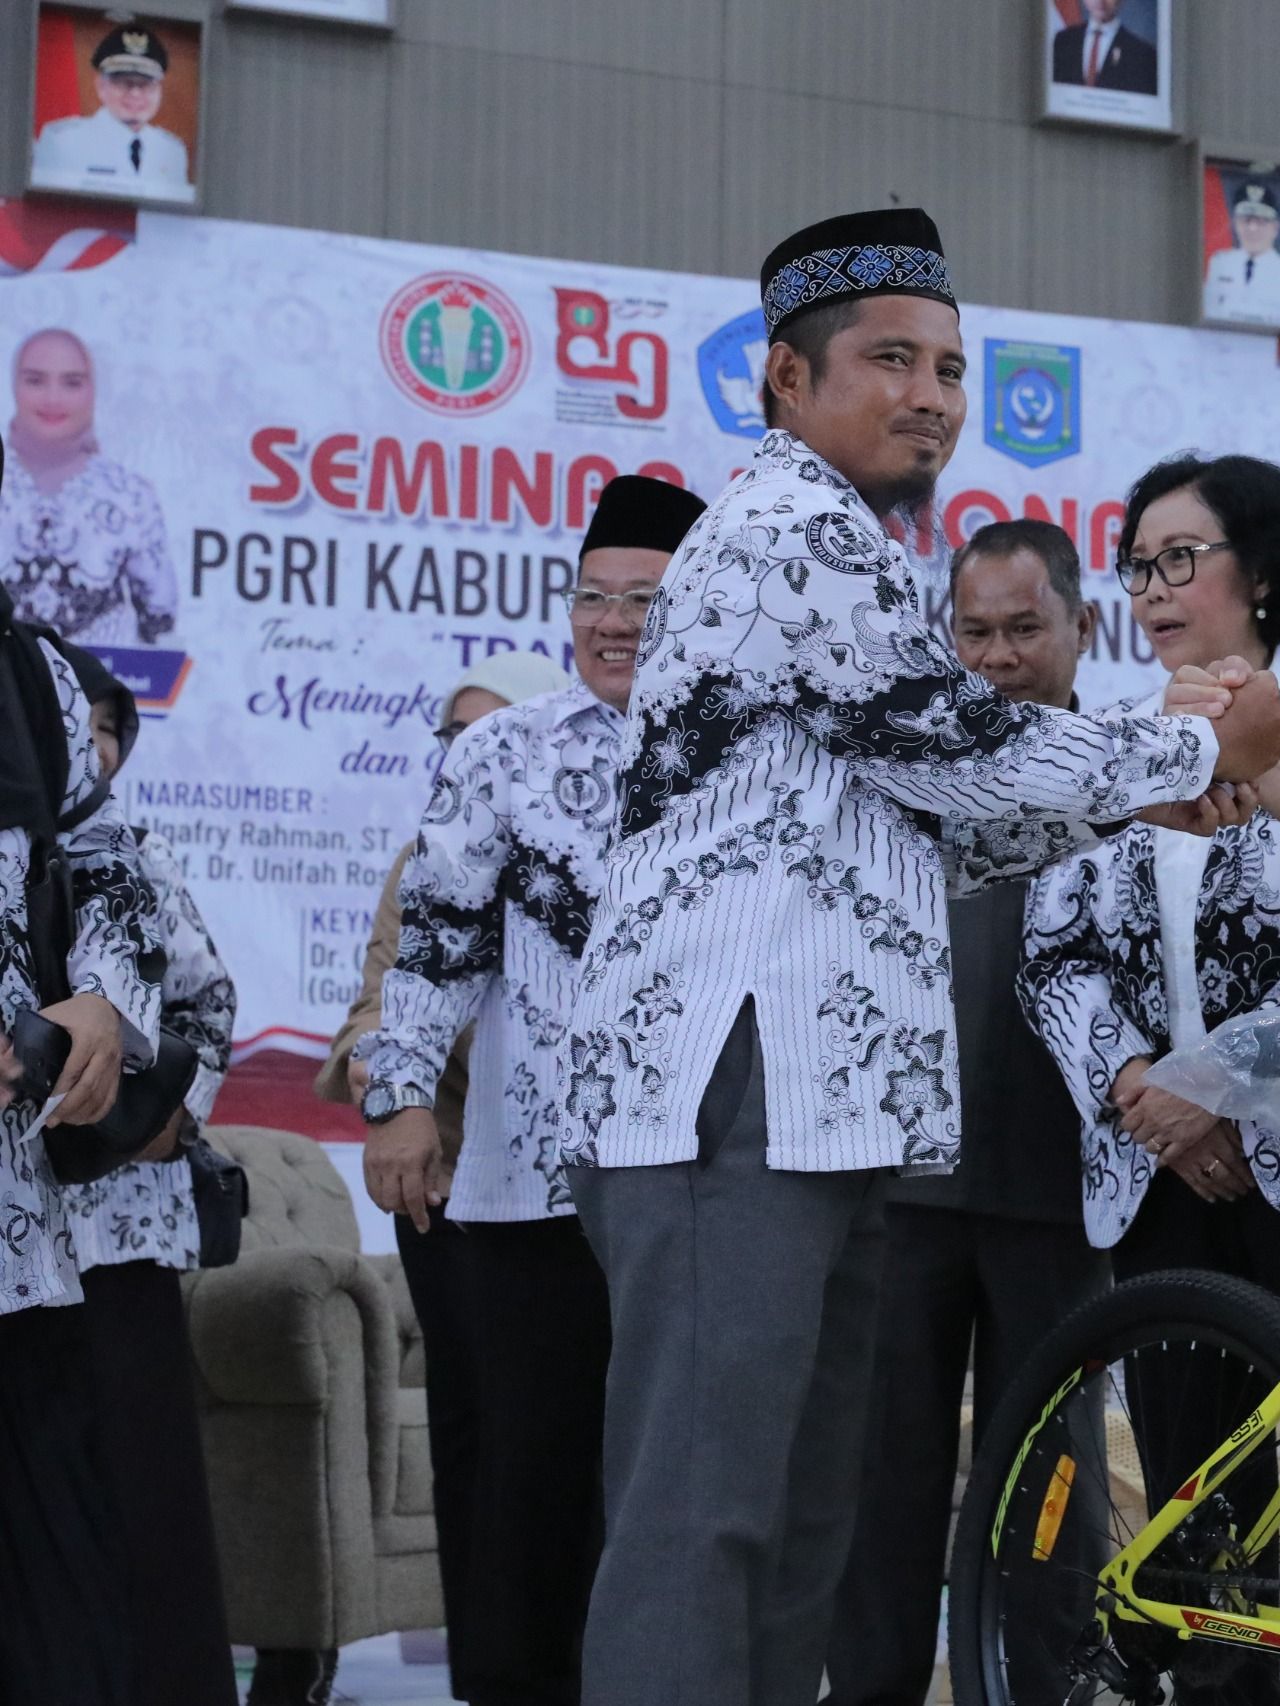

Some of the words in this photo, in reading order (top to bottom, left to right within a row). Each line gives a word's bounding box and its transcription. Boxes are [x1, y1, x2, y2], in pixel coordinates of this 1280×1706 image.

[192, 528, 337, 607] PGRI
[259, 617, 338, 653] Tema
[340, 739, 411, 777] dan
[137, 781, 313, 814] NARASUMBER
[208, 855, 243, 882] Dr.
[253, 858, 337, 886] Unifah
[310, 942, 345, 968] Dr.
[1202, 1619, 1262, 1641] GENIO
